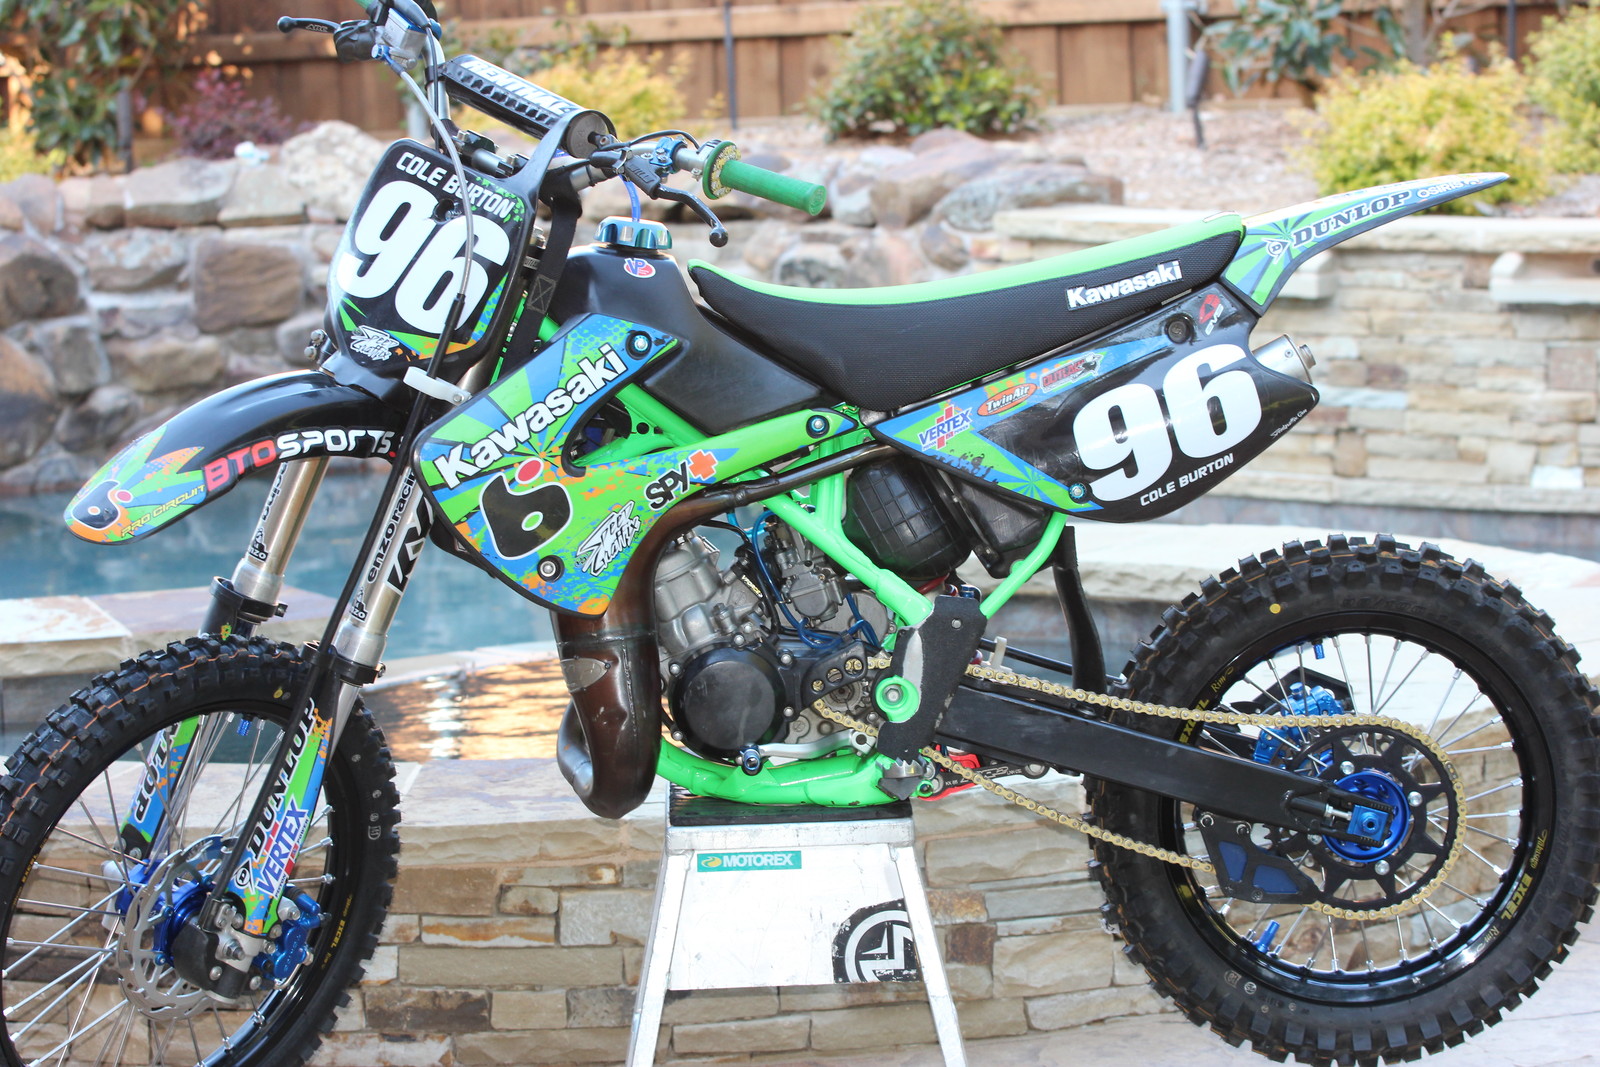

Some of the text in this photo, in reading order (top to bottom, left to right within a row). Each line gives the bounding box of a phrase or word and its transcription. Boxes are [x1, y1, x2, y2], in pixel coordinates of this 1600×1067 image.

[396, 151, 515, 219] COLE BURTON
[1292, 190, 1412, 248] DUNLOP
[336, 180, 510, 334] 96
[624, 257, 647, 275] VP
[1066, 260, 1183, 311] Kawasaki
[433, 343, 628, 489] Kawasaki
[918, 409, 971, 445] VERTEX
[1072, 344, 1262, 501] 96
[1140, 453, 1234, 506] COLE BURTON
[121, 484, 206, 538] PRO CIRCUIT
[257, 800, 308, 894] VERTEX
[723, 853, 794, 867] MOTOREX
[1501, 873, 1533, 920] EXCEL
[331, 920, 346, 948] EXCEL
